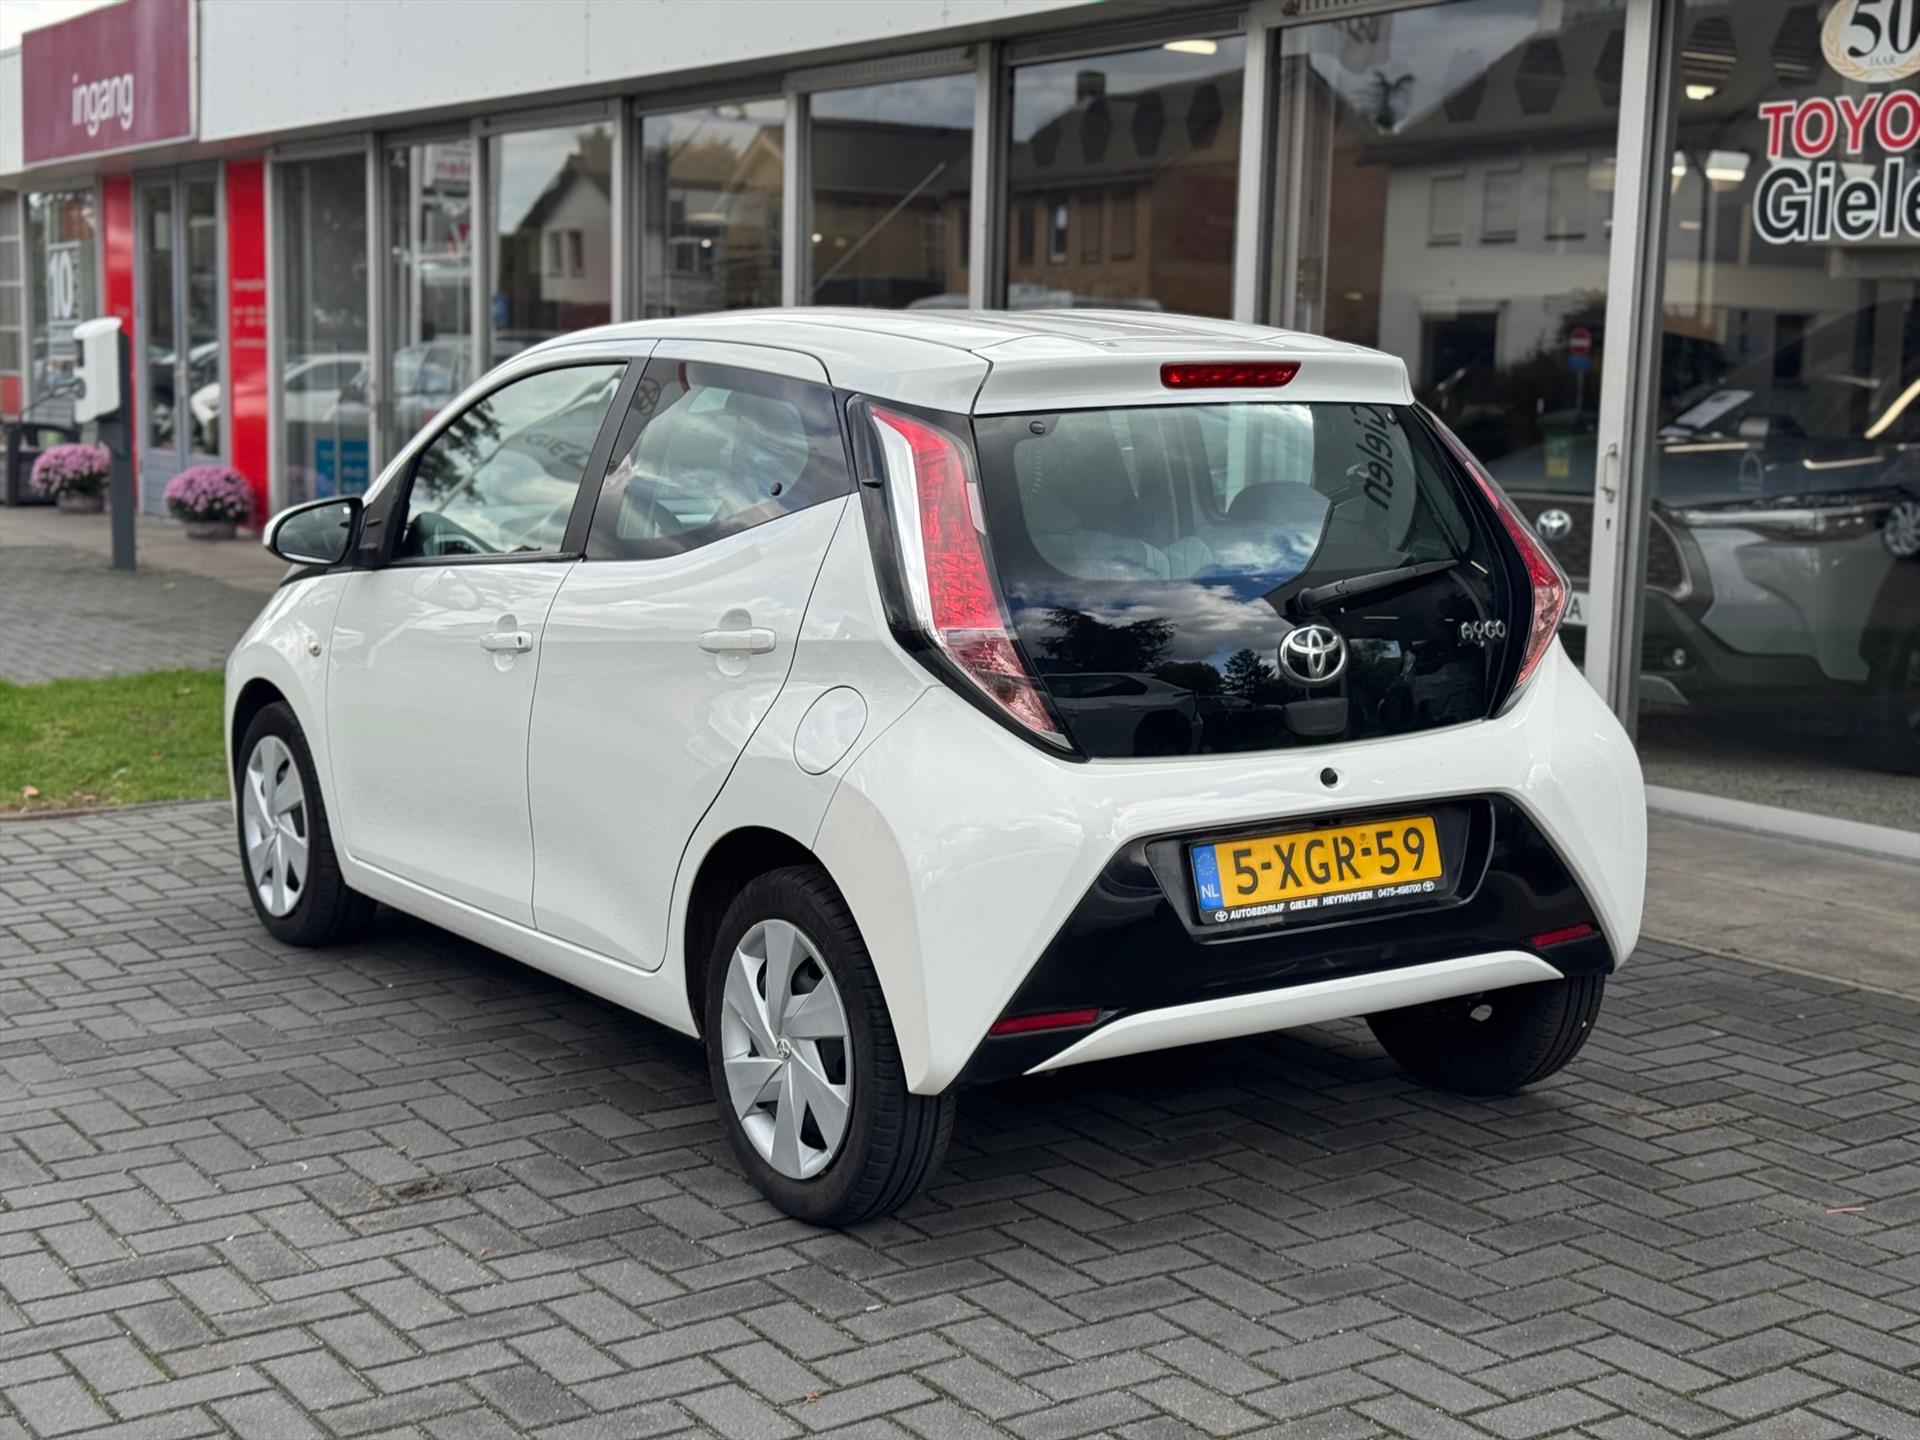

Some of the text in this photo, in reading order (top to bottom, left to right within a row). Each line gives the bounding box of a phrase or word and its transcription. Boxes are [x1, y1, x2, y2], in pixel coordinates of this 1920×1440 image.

[1848, 0, 1920, 57] 50
[1868, 55, 1896, 67] JAAR
[72, 73, 134, 137] ingang
[1461, 620, 1506, 642] AYGO
[1232, 827, 1426, 895] 5-XGR-59
[1201, 884, 1219, 899] NL
[1230, 902, 1285, 920] AUTOBEDRIJF
[1289, 898, 1318, 910] GIELEN
[1322, 890, 1373, 906] HEYTHUYSEN
